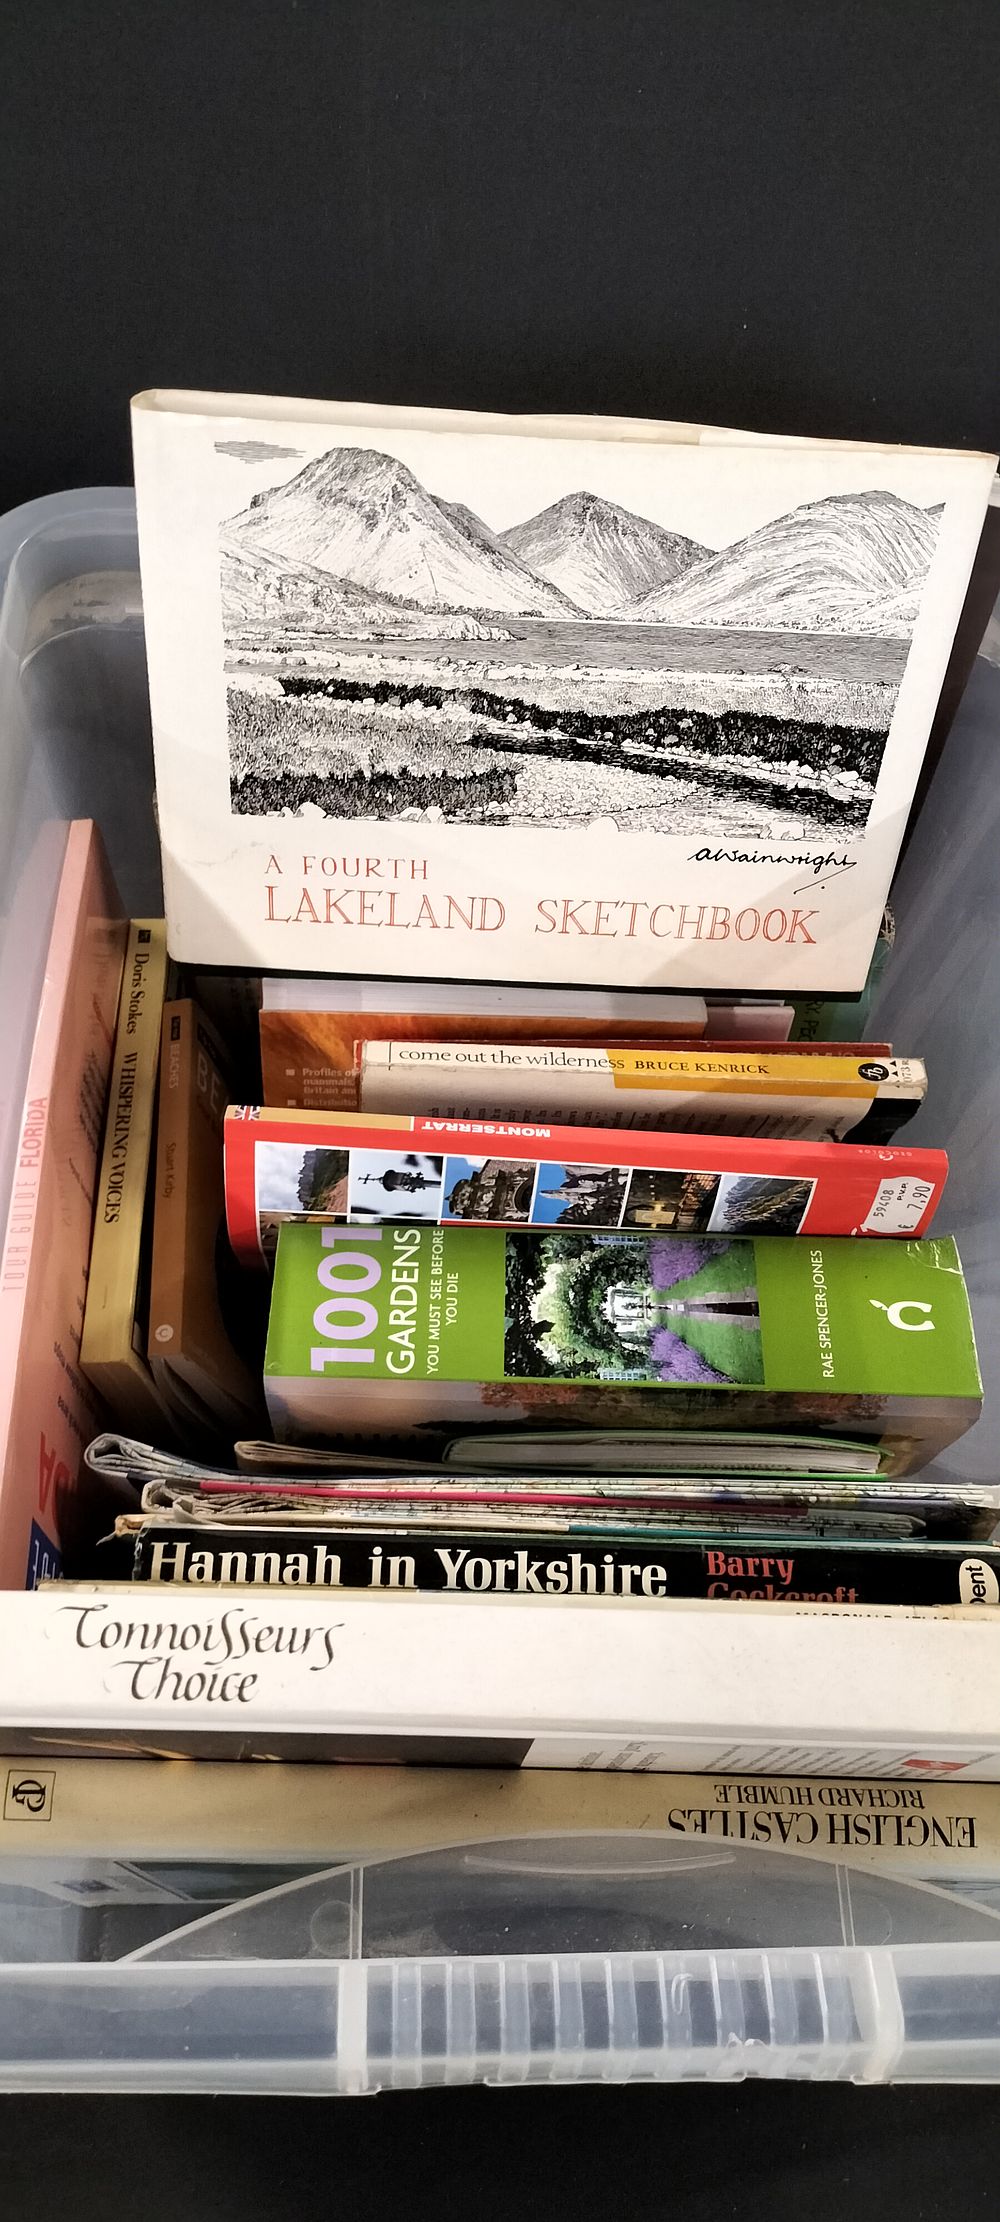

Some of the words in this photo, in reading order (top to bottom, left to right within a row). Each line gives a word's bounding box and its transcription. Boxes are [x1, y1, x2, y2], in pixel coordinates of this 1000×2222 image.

[264, 854, 283, 875] A
[302, 856, 428, 880] FOURTH
[264, 885, 506, 931] LAKELAND
[534, 899, 820, 944] SKETCHBOOK
[131, 952, 150, 989] Doris
[126, 989, 146, 1035] Stokes
[399, 1049, 451, 1063] come
[454, 1051, 487, 1064] out
[490, 1051, 523, 1065] the
[525, 1052, 625, 1070] wilderness
[634, 1059, 689, 1072] BRUCE
[694, 1062, 770, 1075] KENRICK
[111, 1051, 138, 1159] WHISPERING
[19, 1097, 48, 1168] FLORIDA
[421, 1121, 551, 1138] MONTSERRAT
[104, 1161, 127, 1224] VOICES
[872, 1189, 895, 1218] 59408
[896, 1182, 909, 1201] P.V.P.
[906, 1185, 931, 1210] 7,90
[431, 1229, 445, 1276] BEFORE
[310, 1226, 383, 1373] 1001
[430, 1278, 443, 1301] SEE
[446, 1272, 459, 1294] DIE
[810, 1249, 833, 1349] SPENCER-JONES
[385, 1228, 422, 1375] GARDENS
[445, 1297, 459, 1327] YOU
[428, 1303, 442, 1341] MUST
[426, 1344, 440, 1375] YOU
[820, 1352, 835, 1378] RAE
[150, 1541, 342, 1587] Hannah
[367, 1546, 417, 1589] in
[434, 1549, 668, 1598] Yorkshire
[705, 1551, 795, 1585] Barry
[56, 1604, 346, 1671] Connoisseurs
[110, 1656, 259, 1703] Choice
[713, 1784, 812, 1806] HUMBLE
[818, 1787, 926, 1810] RICHARD
[827, 1812, 978, 1848] ENGLISH
